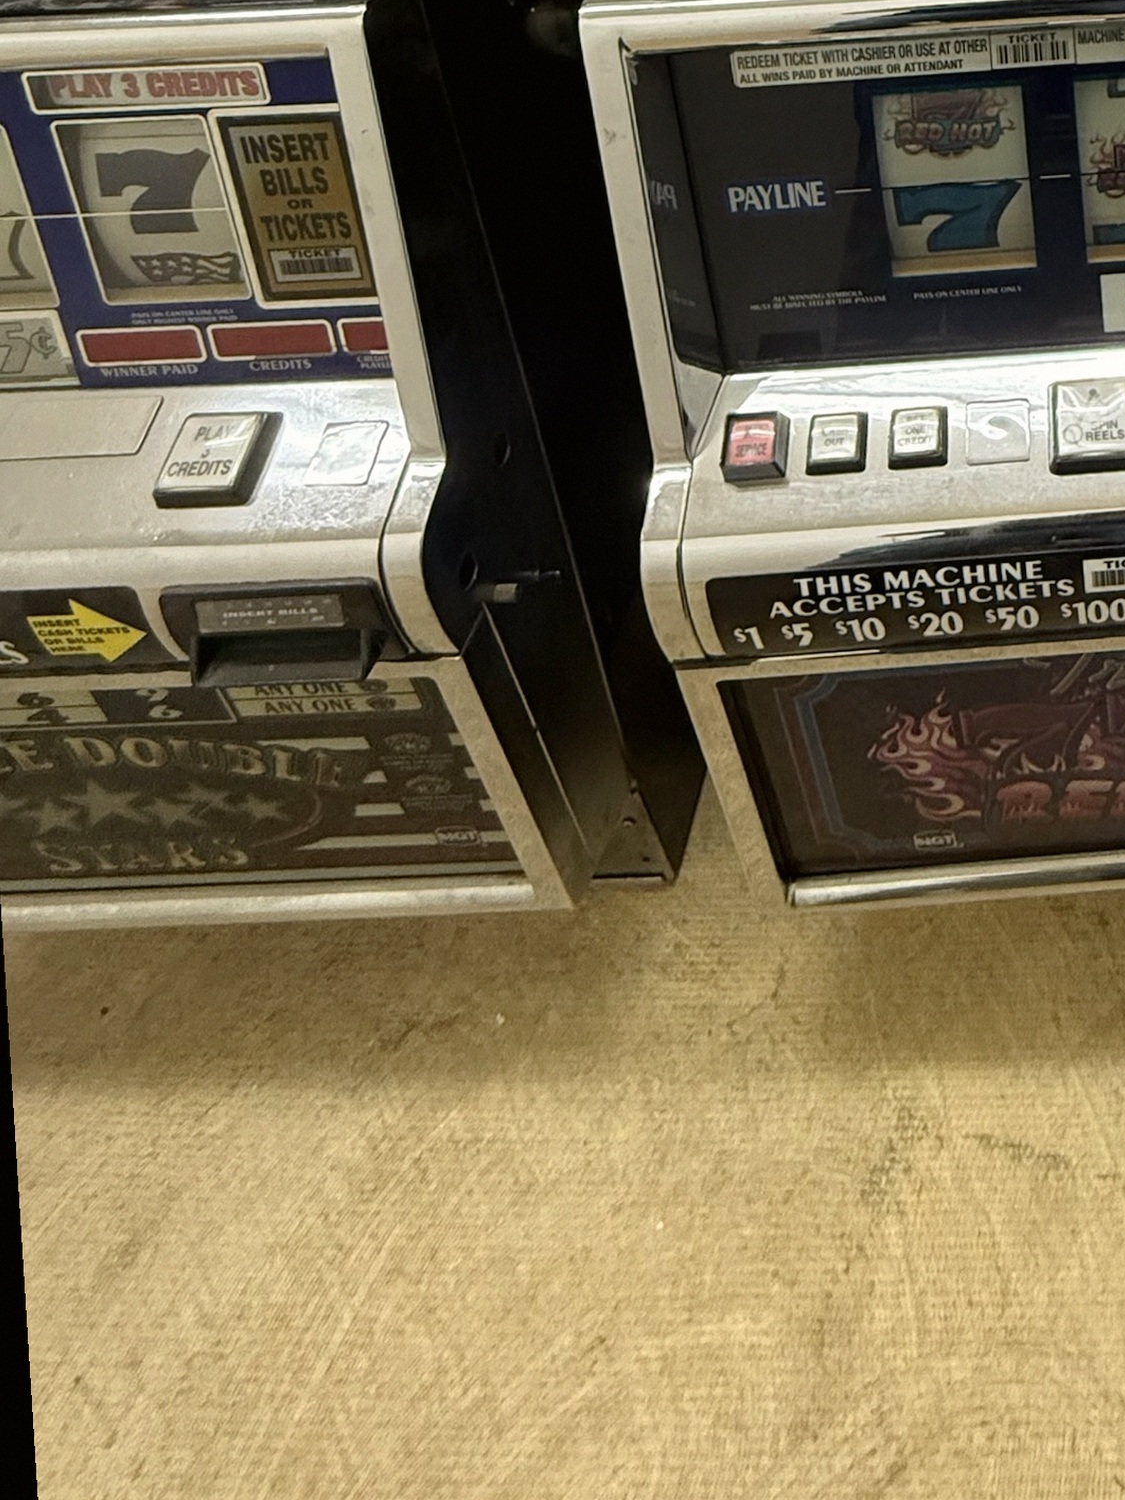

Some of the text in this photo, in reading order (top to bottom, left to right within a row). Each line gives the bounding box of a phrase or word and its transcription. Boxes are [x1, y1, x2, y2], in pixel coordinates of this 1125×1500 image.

[736, 30, 1125, 70] REDEEM TICKET WITH CASHIER OR USE AT OTHER TICKET MACHINE
[739, 59, 964, 83] ALL WINS PAID BY MACHINE OR ATTENDANT
[51, 71, 259, 98] PLAY 3 CREDITS
[897, 121, 998, 142] RED HOT
[239, 132, 330, 164] INSERT
[260, 167, 328, 196] BILLS
[287, 199, 313, 209] OR
[728, 181, 826, 213] PAYLINE
[260, 213, 352, 242] TICKETS
[287, 248, 342, 259] TICKET
[949, 288, 980, 297] CENTER
[101, 362, 199, 379] WINNER PAID
[249, 357, 312, 372] CREDITS
[904, 427, 926, 435] ONE
[1085, 429, 1125, 441] REELS
[823, 437, 845, 447] OUT
[166, 459, 232, 477] CREDITS
[793, 572, 881, 597] THIS
[884, 560, 1043, 590] MACHINE
[770, 579, 1075, 618] ACCEPTS TICKETS
[33, 618, 79, 628] INSERT
[38, 626, 130, 637] CASH TICKETS
[734, 627, 765, 650] $1
[781, 624, 814, 647] $5
[836, 617, 886, 642] $10
[907, 610, 964, 637] $20
[985, 605, 1040, 630] $50
[264, 697, 358, 713] ANY ONE
[63, 736, 343, 788] DOUBLE
[35, 841, 249, 873] STARS
